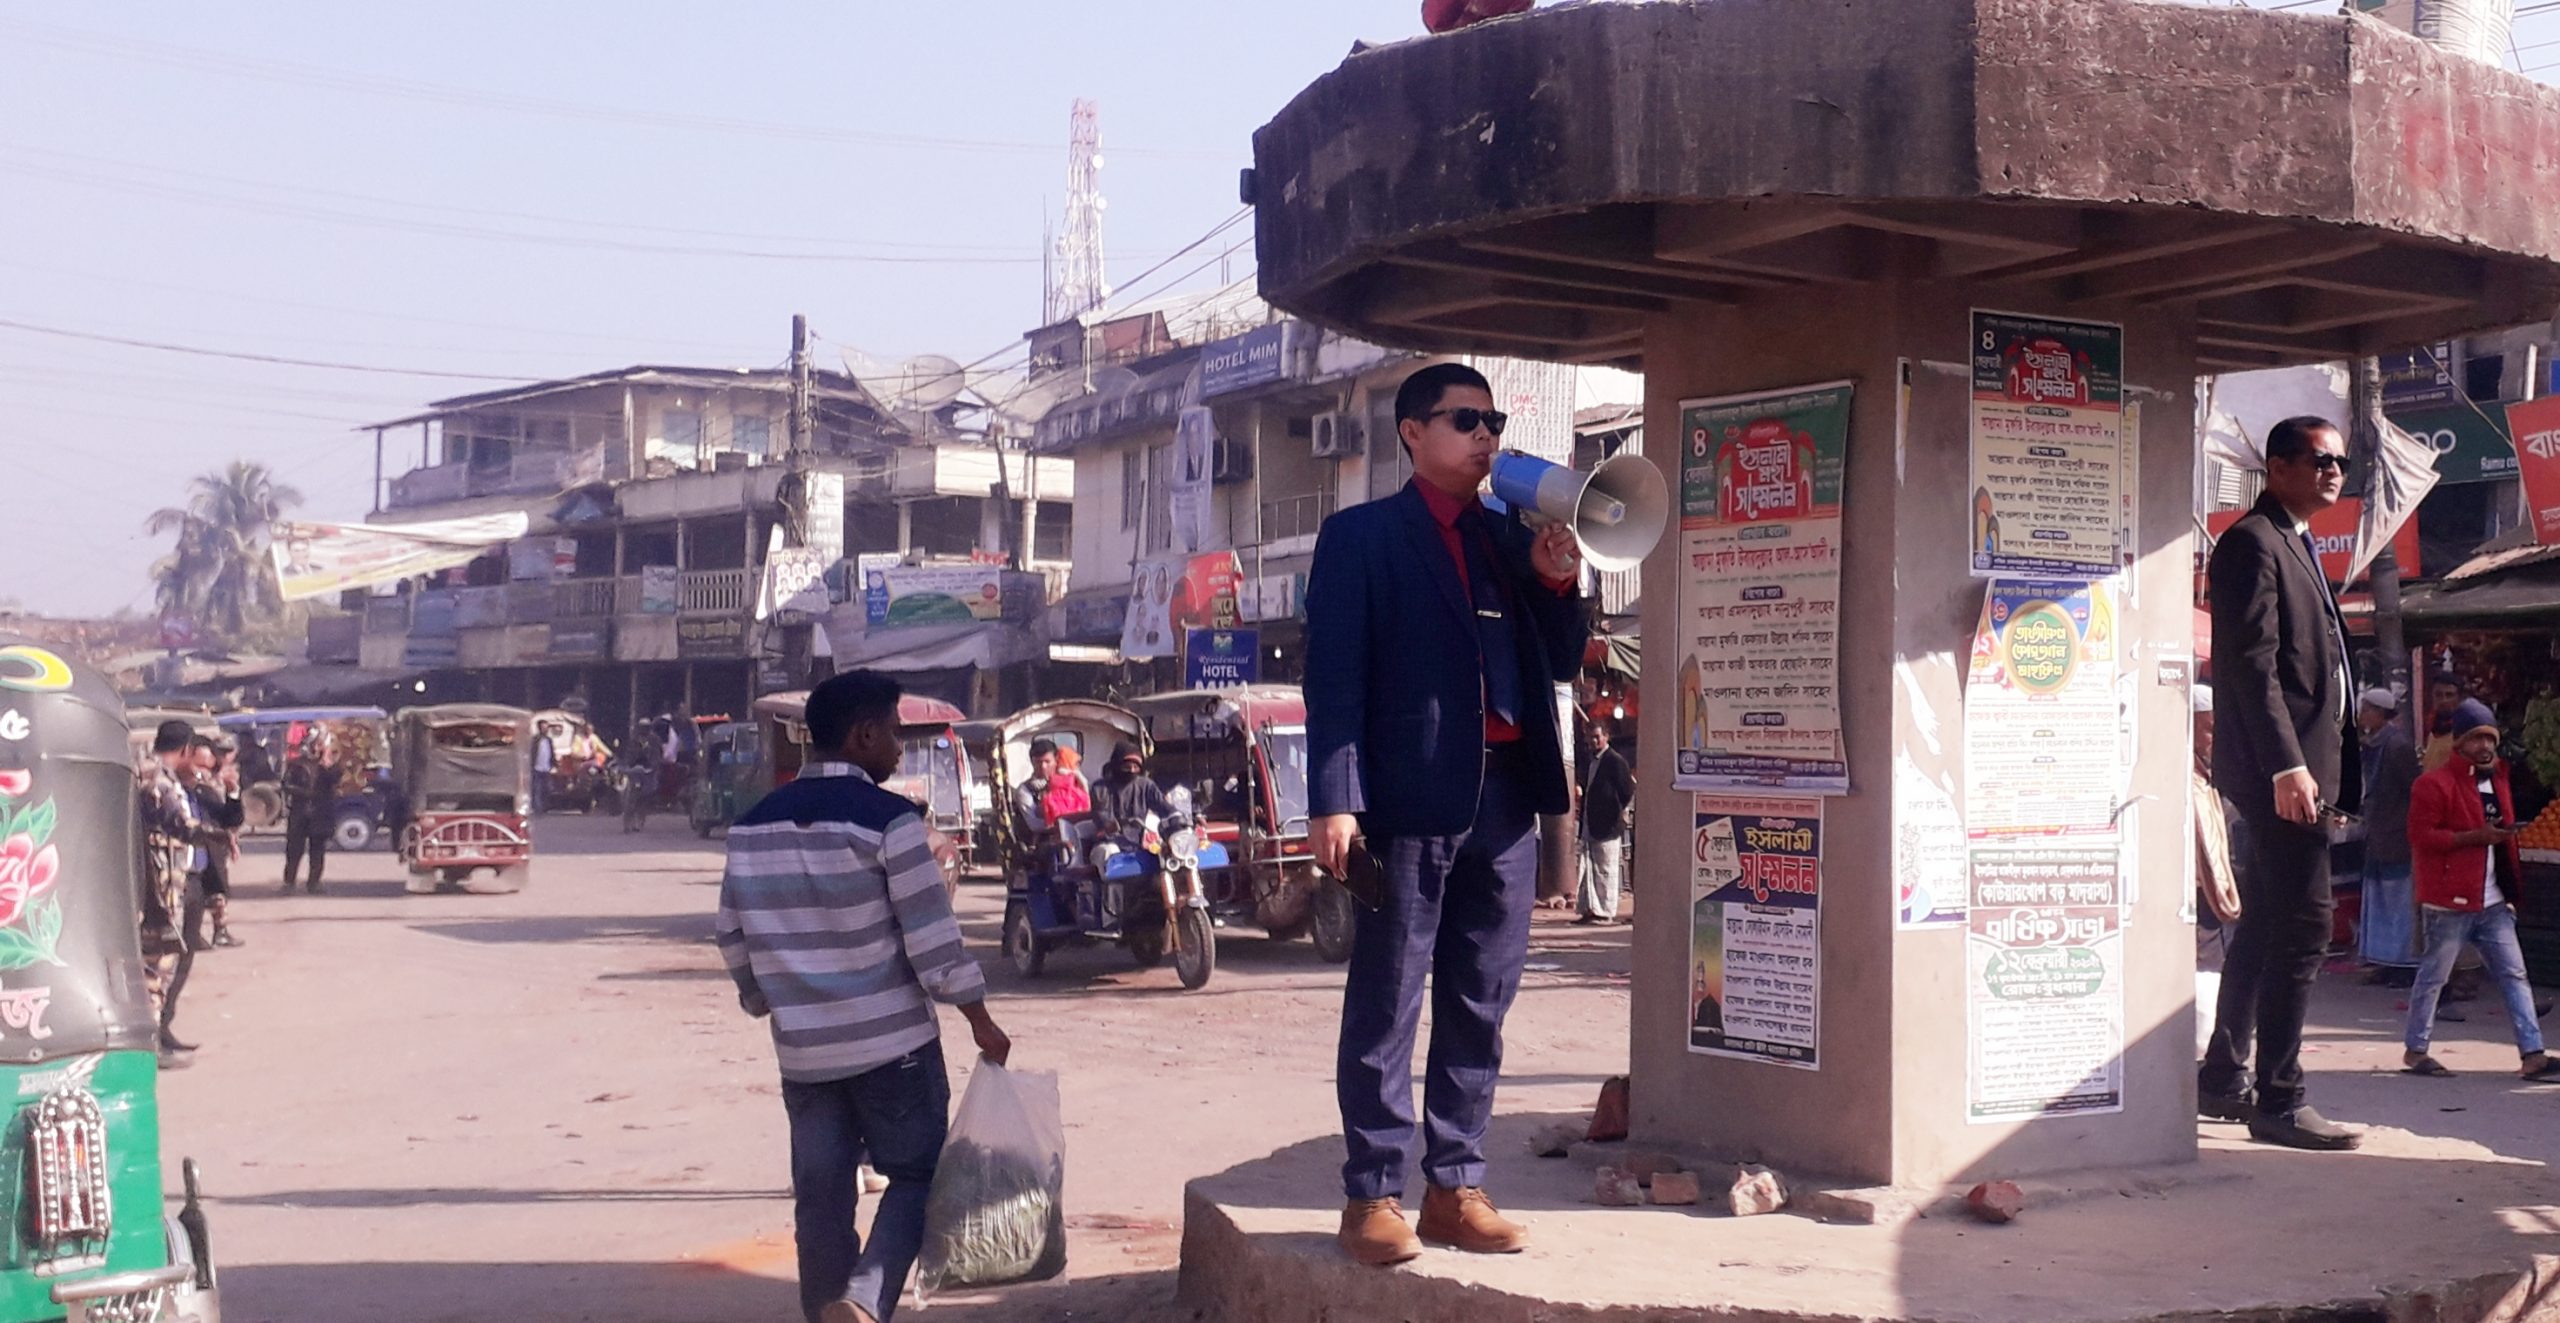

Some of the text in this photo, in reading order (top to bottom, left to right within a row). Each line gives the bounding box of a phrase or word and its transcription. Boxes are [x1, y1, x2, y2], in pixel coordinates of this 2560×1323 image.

[1982, 330, 1996, 350] ৪
[1205, 341, 1278, 374] HOTEL MIM
[2023, 370, 2076, 401] সম্মেলন
[1694, 429, 1707, 457] ৪
[1736, 439, 1791, 477] ইসলামী
[1735, 473, 1796, 518] সম্মেলন
[1202, 665, 1239, 678] HOTEL
[1703, 686, 1742, 699] মাওলানা
[1697, 828, 1710, 863] ৫
[1744, 826, 1813, 852] ইসলামী
[1737, 851, 1818, 903] সম্মেলন
[1986, 909, 2058, 942] বার্ষিক
[1997, 950, 2023, 973] ১২
